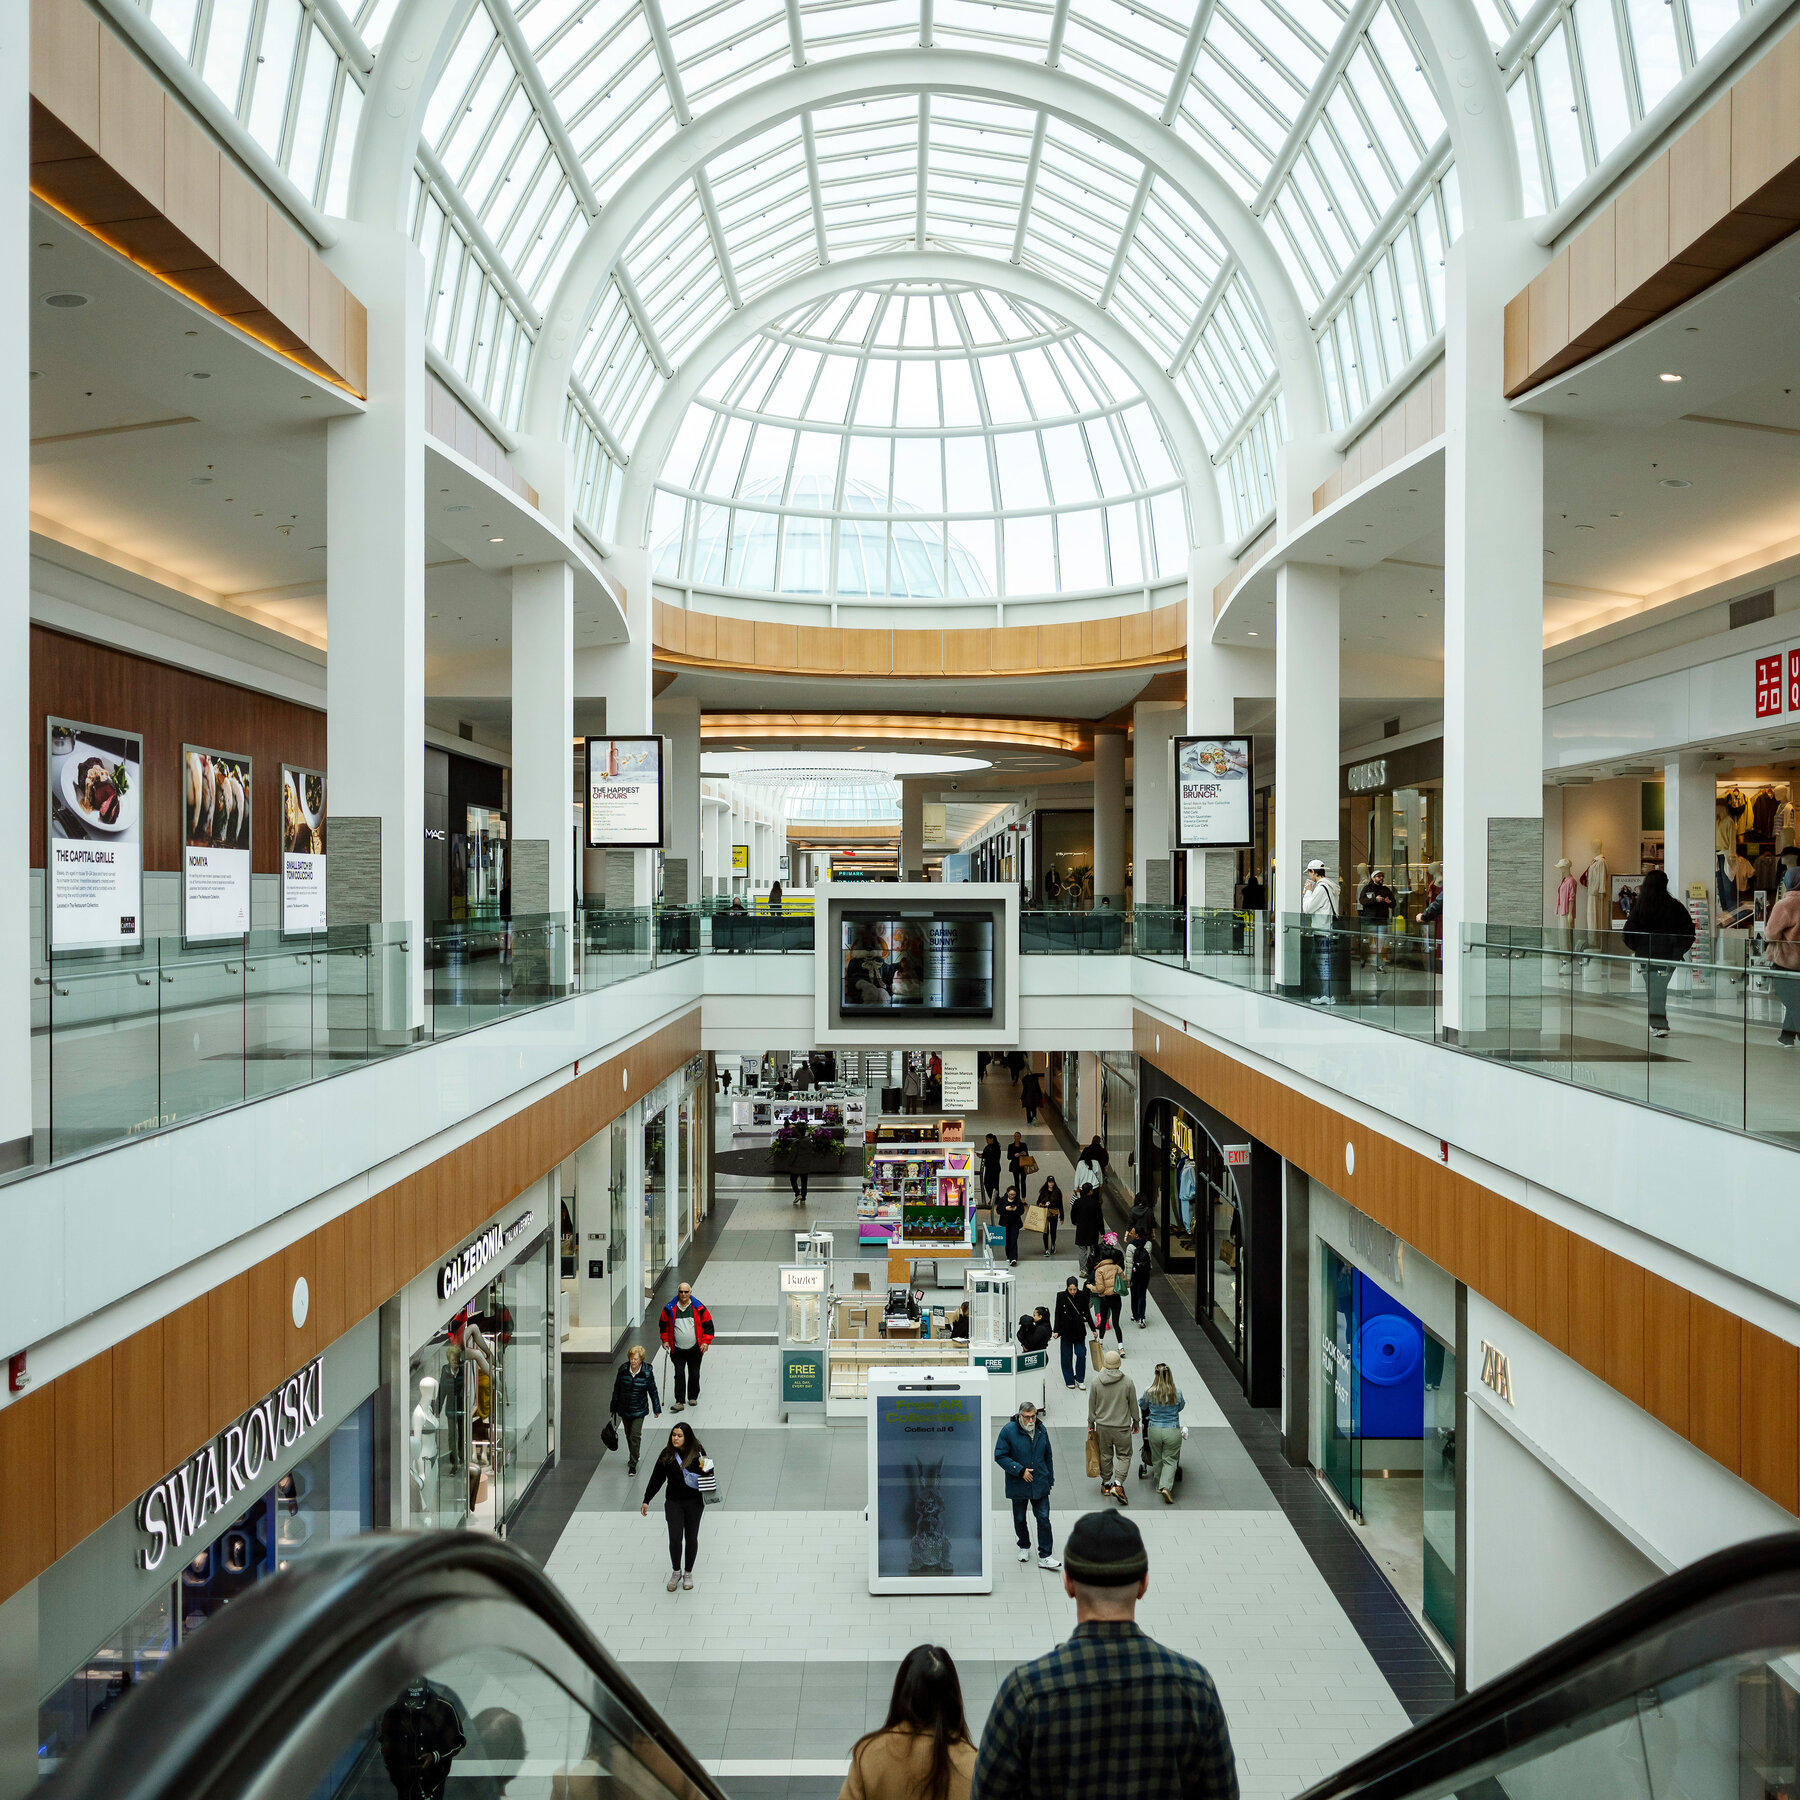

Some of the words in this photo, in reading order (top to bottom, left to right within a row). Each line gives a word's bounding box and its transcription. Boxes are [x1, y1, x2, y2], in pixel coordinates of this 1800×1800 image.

[1200, 784, 1222, 792] FIRST,
[56, 850, 69, 862] THE
[70, 850, 95, 863] CAPITAL
[95, 852, 114, 863] GRILLE
[189, 856, 208, 866] NOMIYA
[286, 861, 297, 869] SMALL
[1228, 1151, 1246, 1163] EXIT
[441, 1222, 504, 1300] CALZEDONIA
[788, 1274, 817, 1284] Banter
[1322, 1333, 1336, 1361] LOOK
[1337, 1349, 1349, 1374] SICK
[1025, 1355, 1038, 1364] FREE
[1322, 1352, 1333, 1375] RUN
[789, 1365, 816, 1374] FREE
[1335, 1380, 1348, 1406] FAST
[896, 1400, 935, 1410] Free
[939, 1400, 962, 1410] AR
[886, 1412, 973, 1423] Collectible!
[143, 1356, 324, 1570] SWAROVSKI
